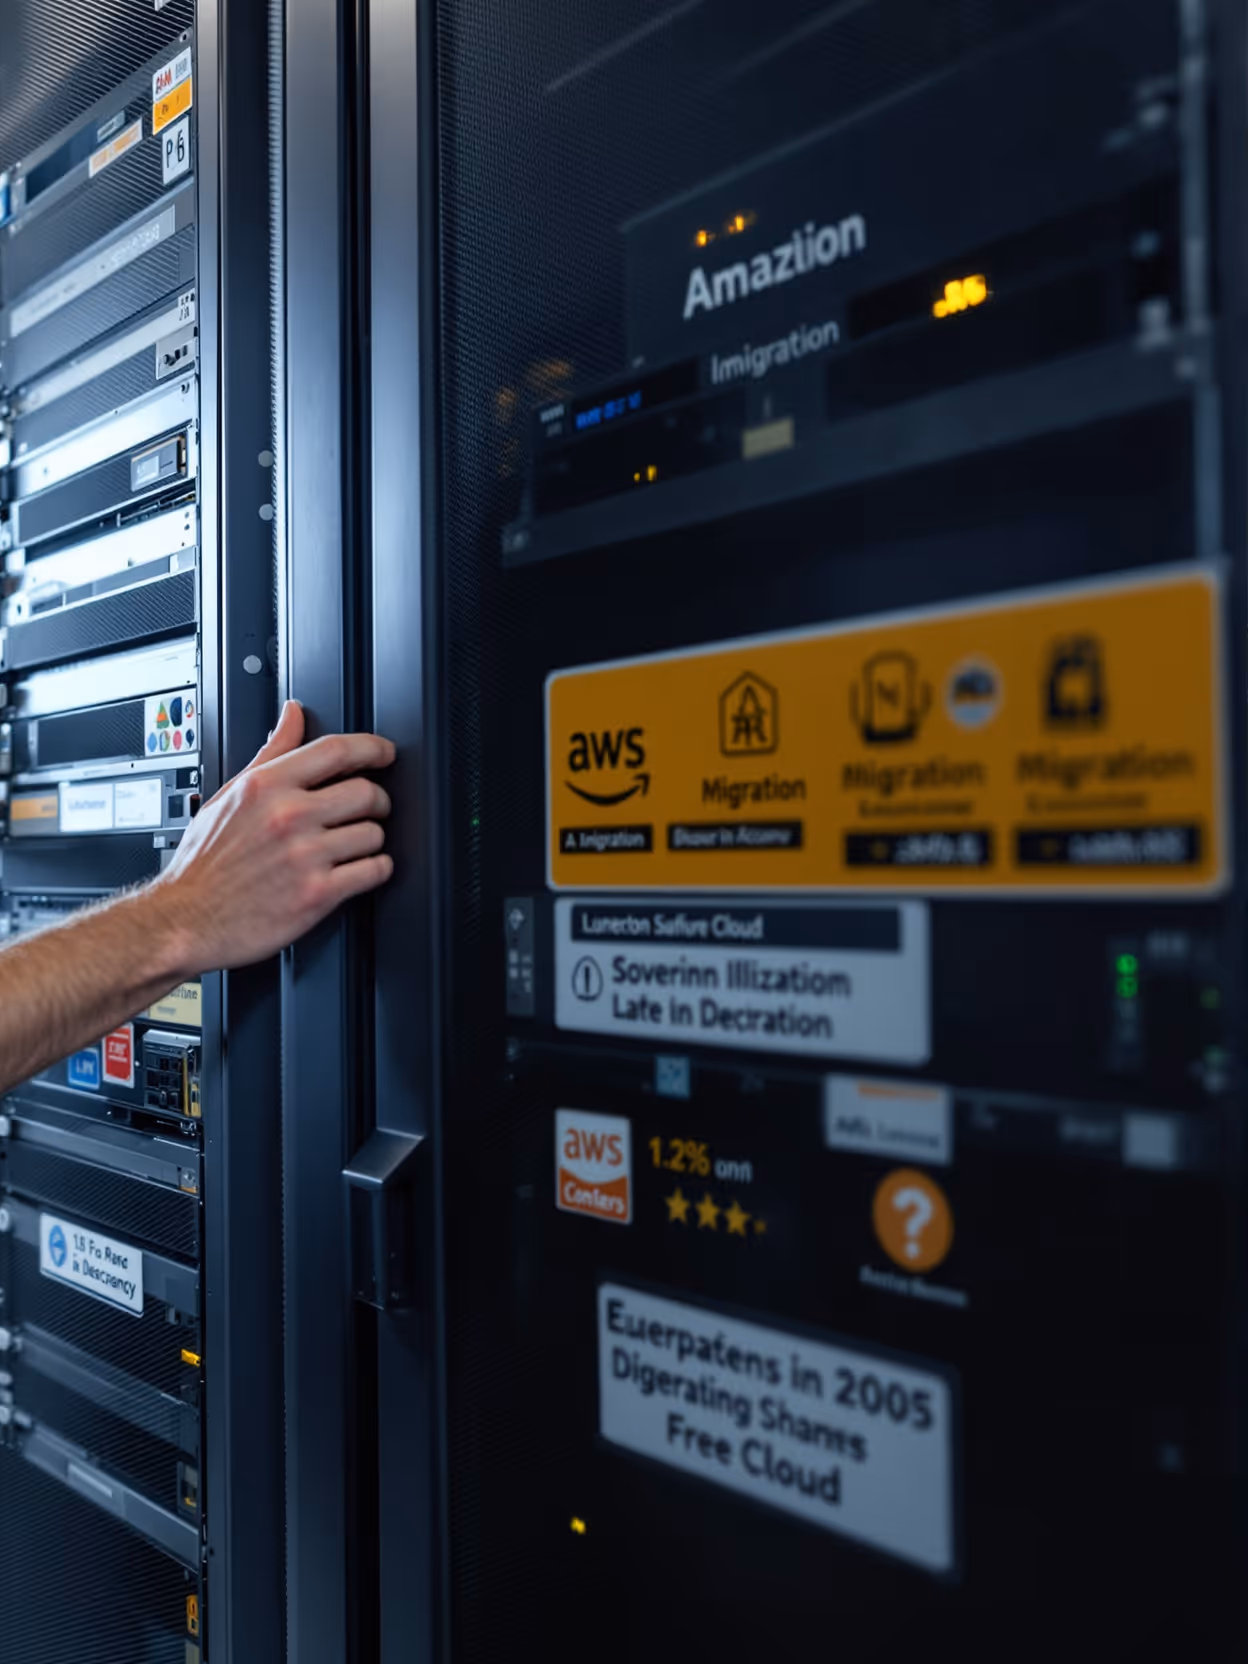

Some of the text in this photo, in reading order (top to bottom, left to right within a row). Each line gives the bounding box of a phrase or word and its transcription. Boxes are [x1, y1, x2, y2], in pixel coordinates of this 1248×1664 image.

[567, 727, 646, 772] aws
[701, 772, 807, 810] Migration
[711, 914, 764, 939] Cloud
[612, 995, 663, 1025] Late
[563, 1127, 624, 1168] aws
[649, 1135, 711, 1177] 1.2%
[834, 1366, 936, 1432] 2005
[666, 1411, 843, 1507] Free Cloud
